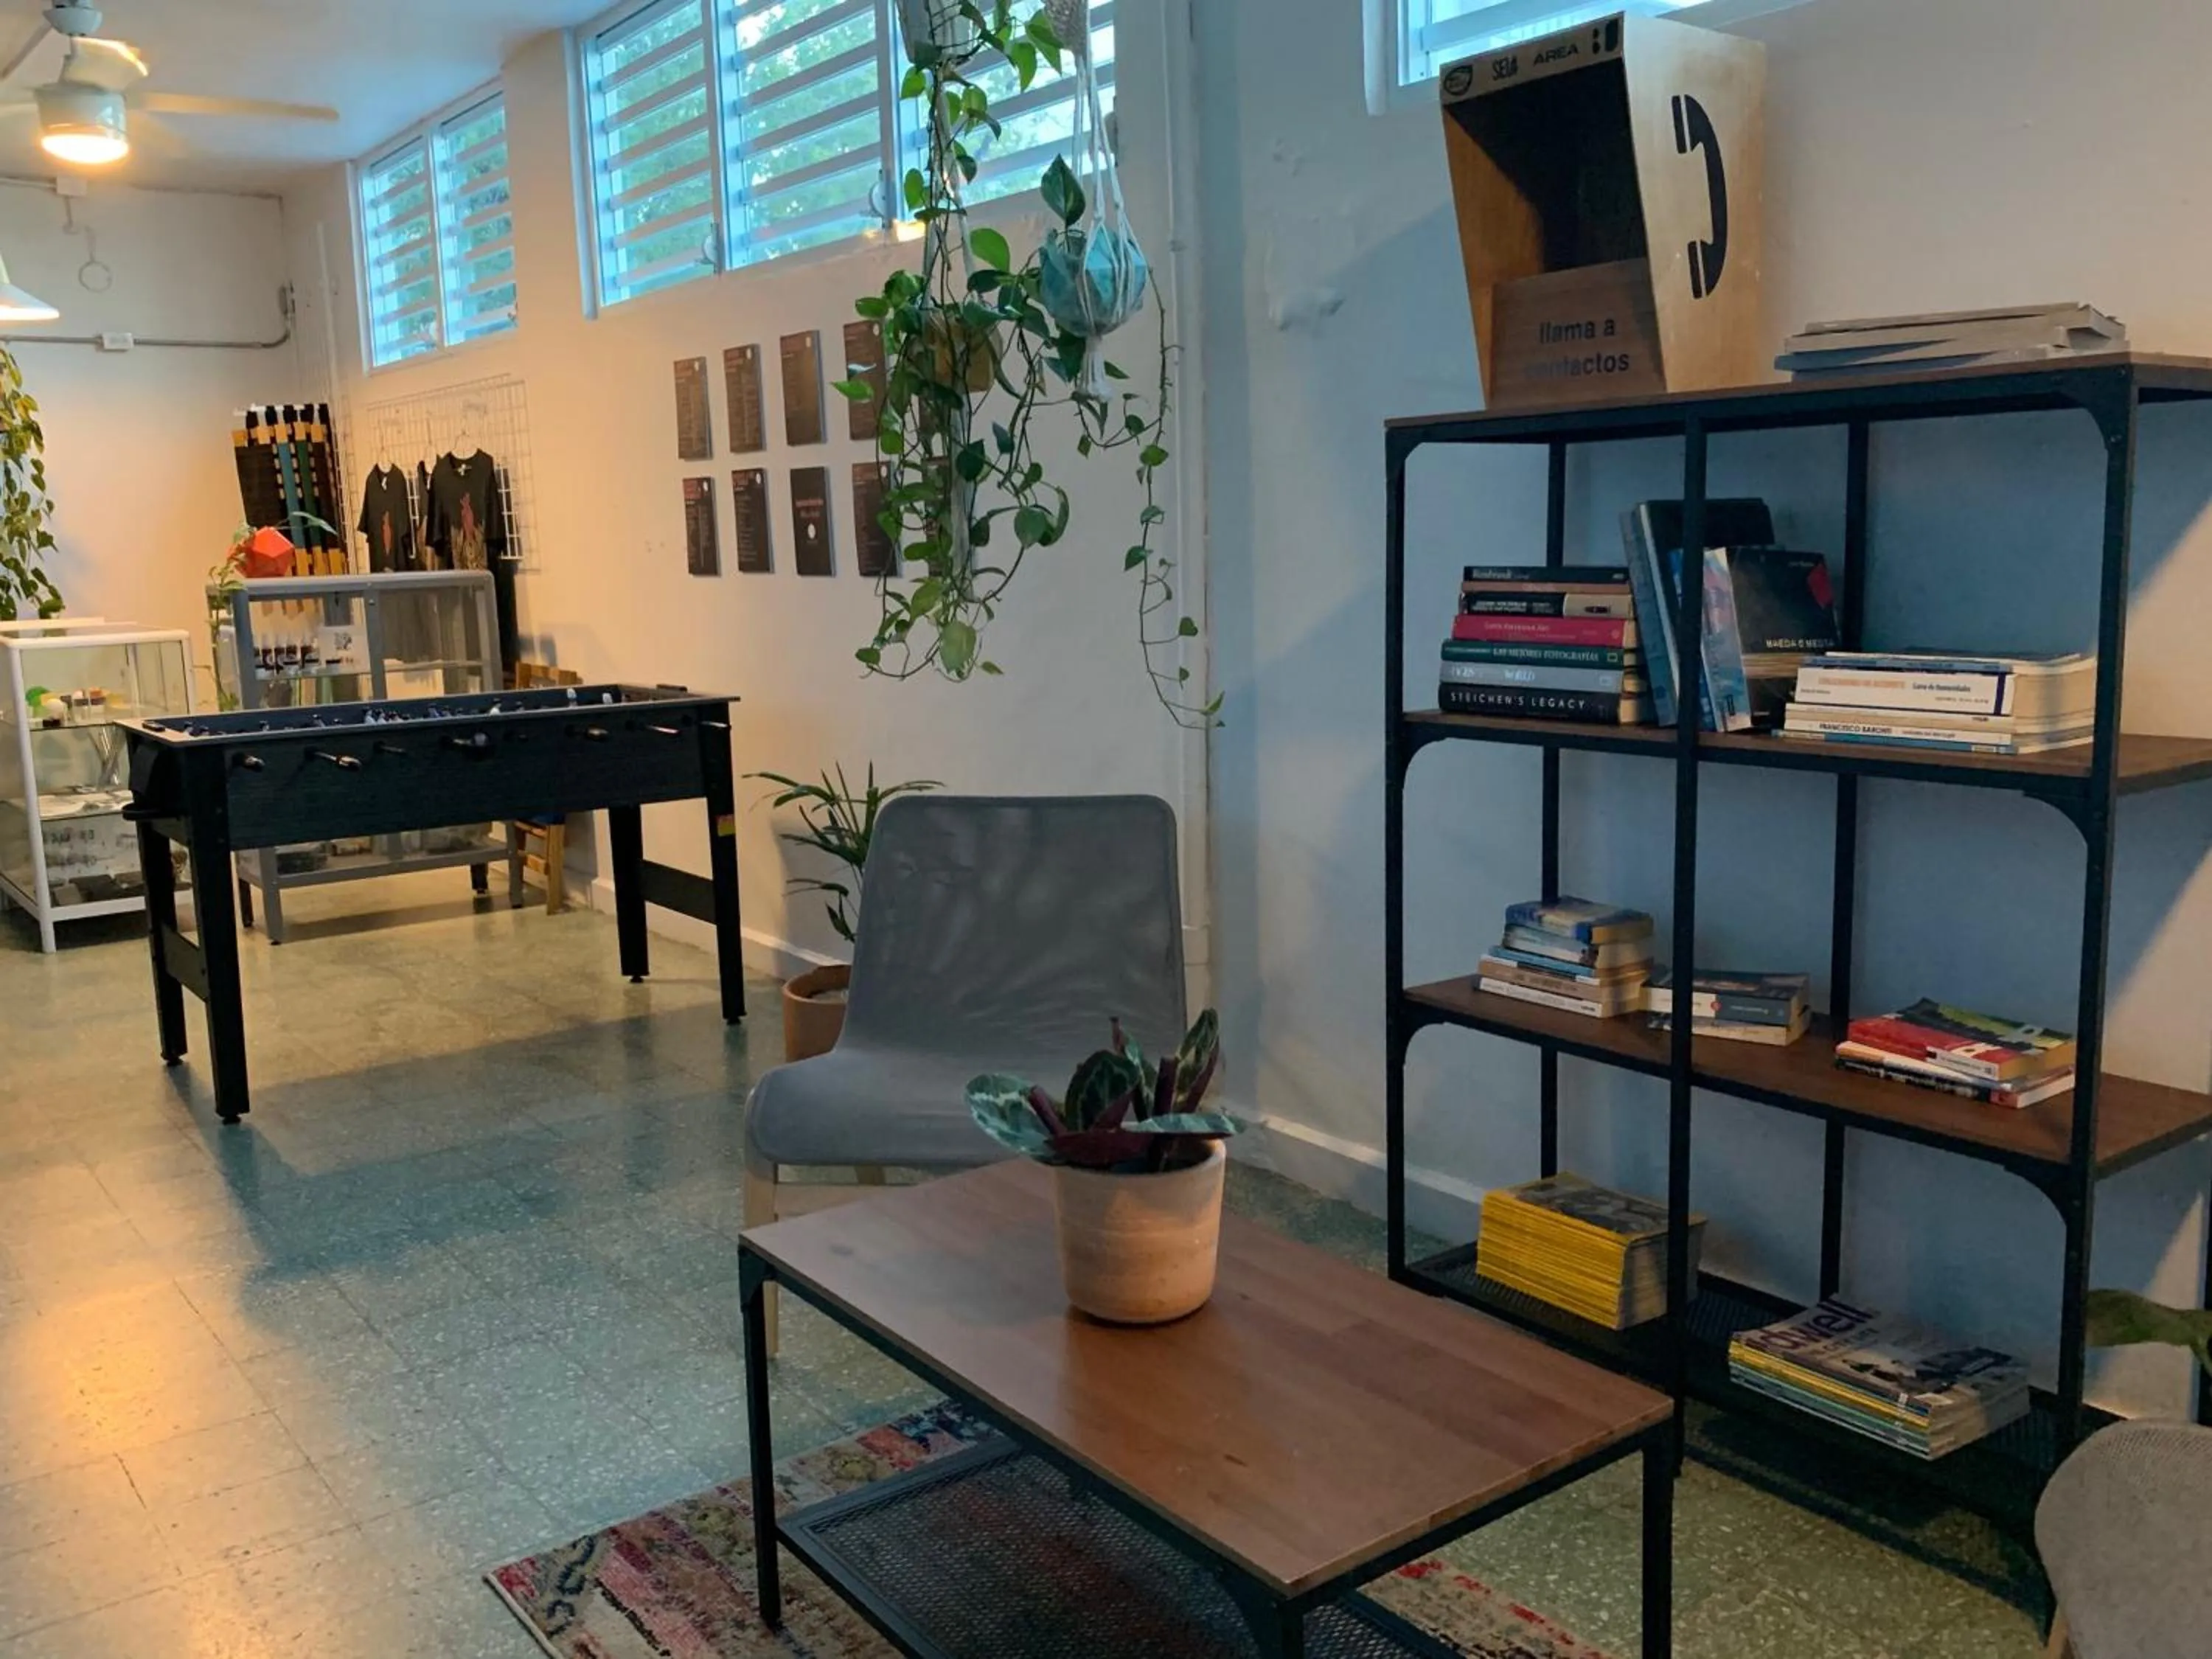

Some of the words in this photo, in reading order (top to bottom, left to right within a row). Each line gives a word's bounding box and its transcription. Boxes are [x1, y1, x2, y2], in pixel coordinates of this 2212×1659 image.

[1534, 44, 1579, 66] AREA
[1540, 321, 1596, 344] llama
[1604, 319, 1615, 336] a
[1525, 352, 1630, 378] ntactos
[1450, 692, 1524, 706] STEICHEN'S
[1531, 697, 1586, 709] LEGACY
